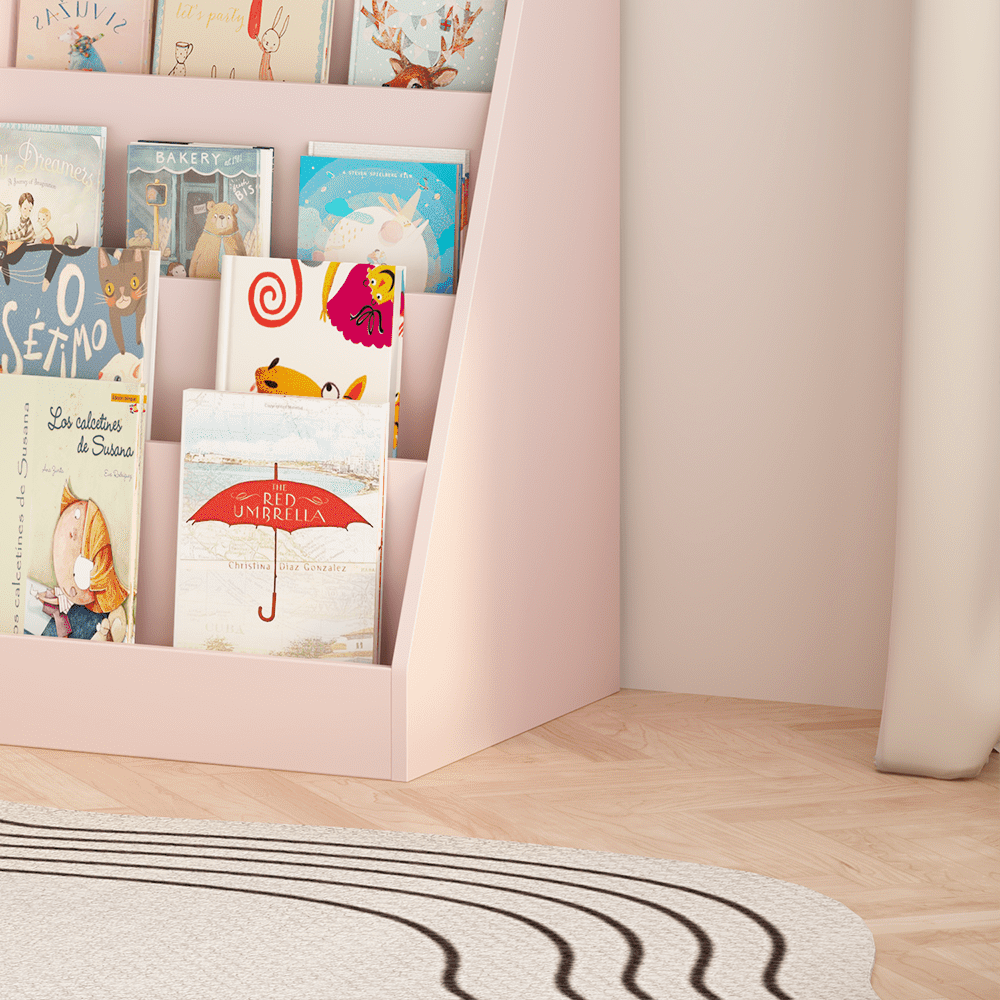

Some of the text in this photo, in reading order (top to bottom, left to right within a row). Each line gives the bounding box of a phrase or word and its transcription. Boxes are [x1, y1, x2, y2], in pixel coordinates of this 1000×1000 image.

[205, 6, 246, 33] party
[15, 137, 94, 190] Dreamers
[156, 151, 221, 166] BAKERY
[234, 184, 255, 201] BIS
[57, 263, 86, 327] O
[47, 406, 123, 433] Los calcetines
[17, 402, 30, 479] Susana
[77, 434, 135, 458] de Susana
[16, 484, 26, 507] de
[272, 483, 288, 491] THE
[263, 491, 297, 508] RED
[233, 504, 327, 523] UMBRELLA
[11, 514, 25, 609] calcetines
[228, 561, 271, 571] Christina
[303, 562, 347, 573] Gonzalez
